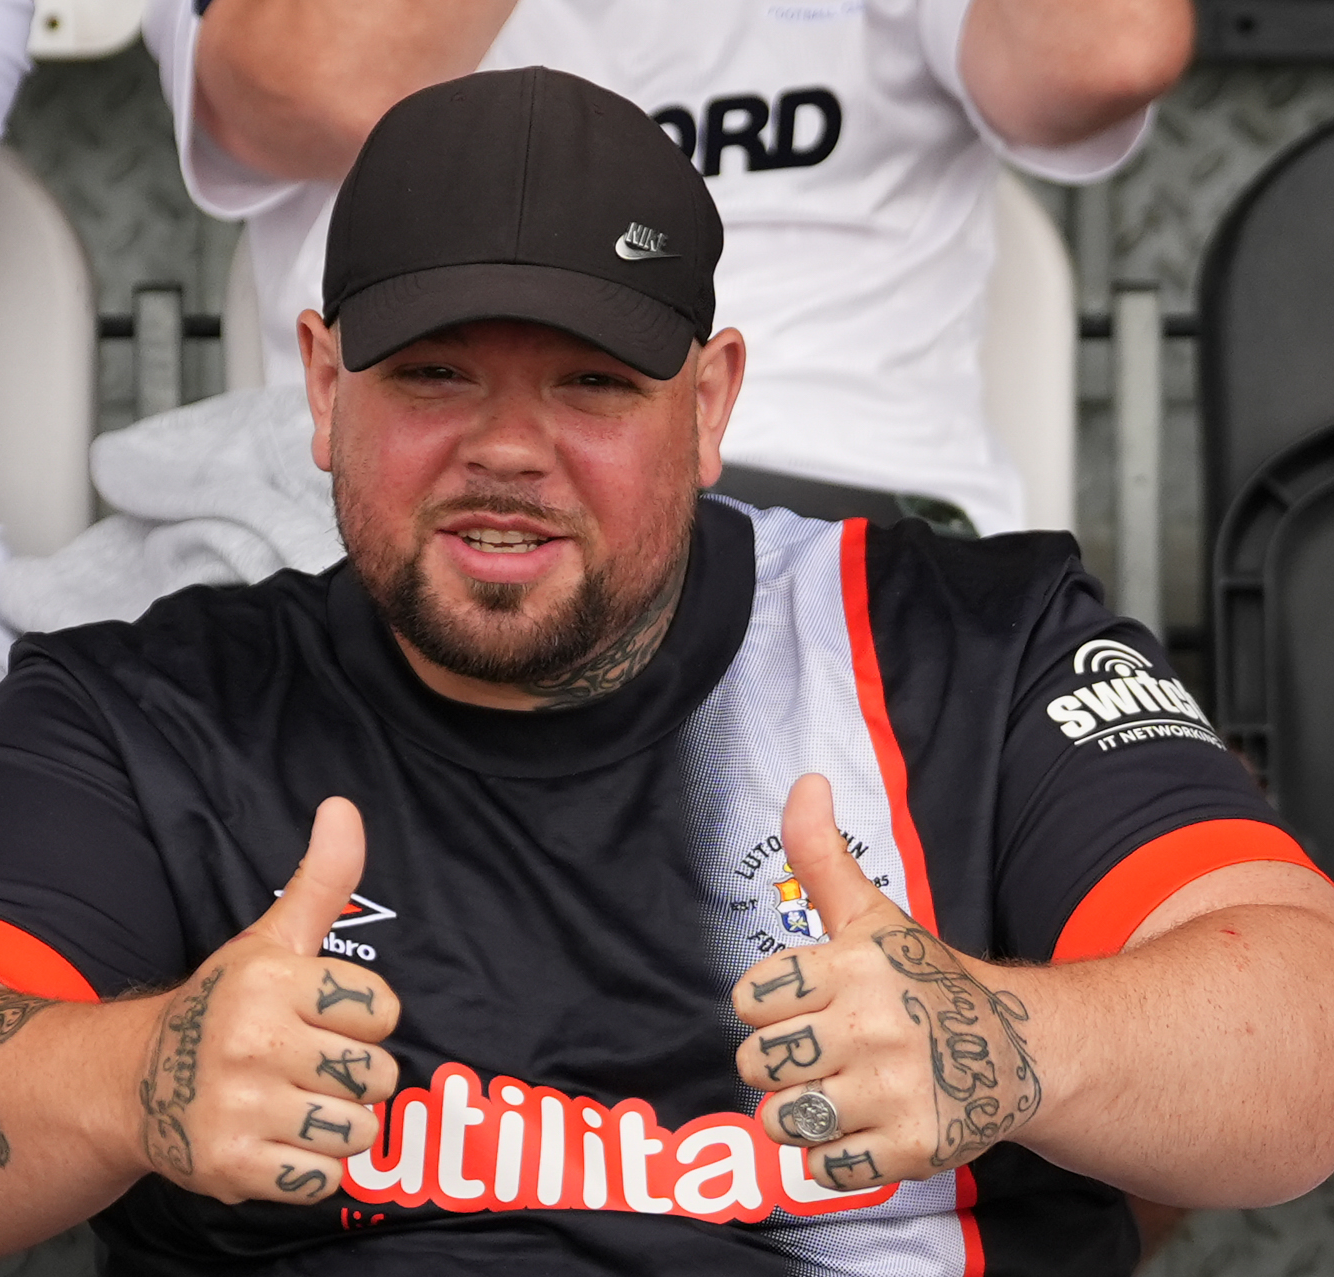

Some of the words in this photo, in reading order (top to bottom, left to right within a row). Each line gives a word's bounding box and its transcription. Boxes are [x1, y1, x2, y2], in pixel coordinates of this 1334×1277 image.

[625, 221, 669, 252] NIKE
[1097, 735, 1118, 751] IT
[735, 835, 782, 880] LUTO
[347, 1073, 763, 1215] utilita
